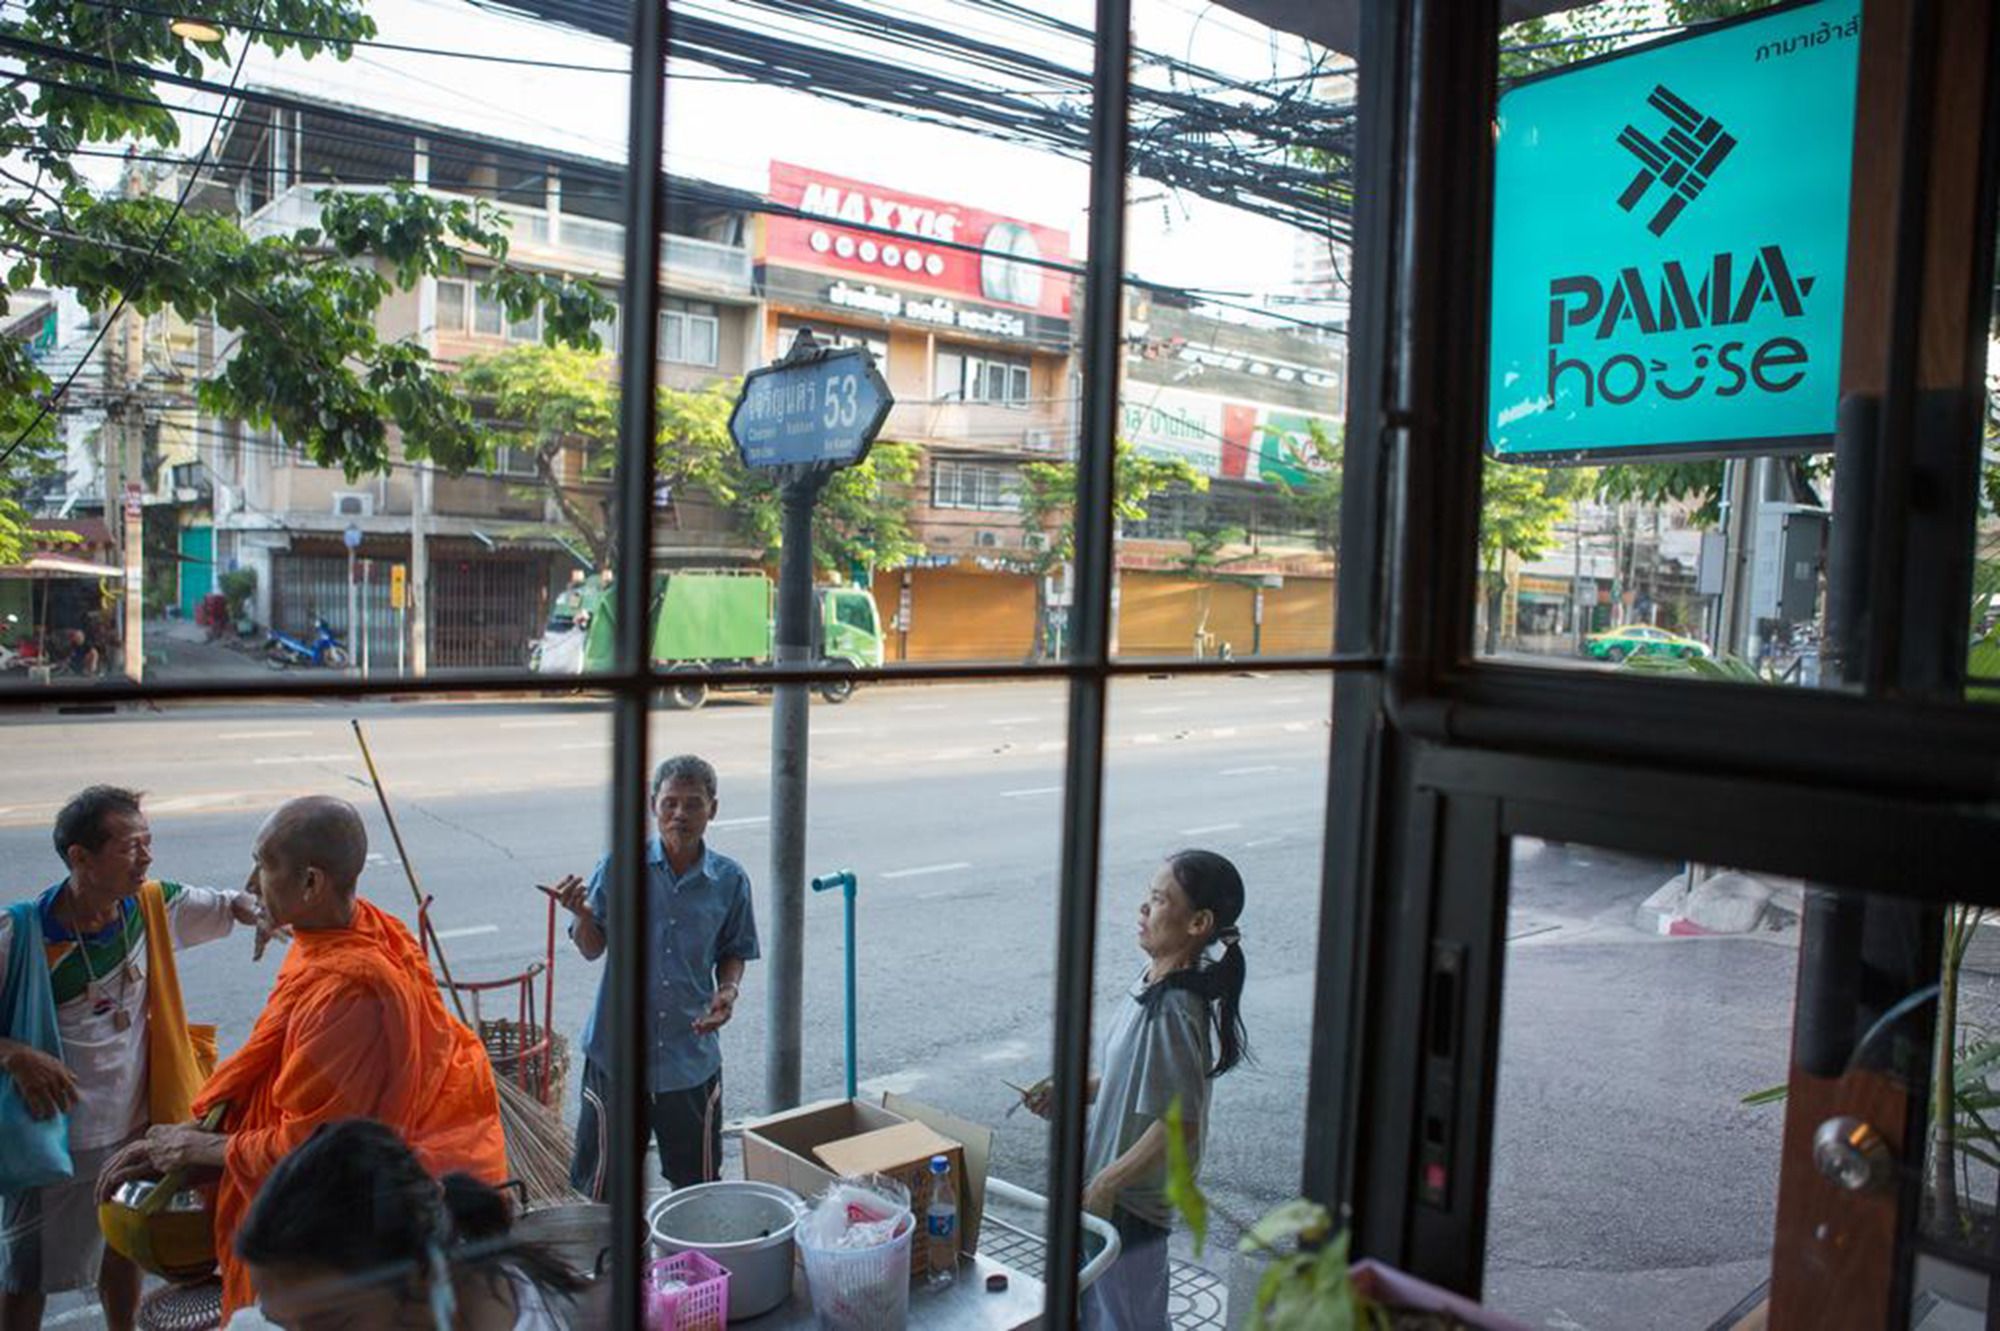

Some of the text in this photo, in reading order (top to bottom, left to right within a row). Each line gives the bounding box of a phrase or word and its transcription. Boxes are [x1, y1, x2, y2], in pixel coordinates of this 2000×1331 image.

[800, 183, 957, 243] MAXXIS
[1549, 245, 1816, 345] PAMA
[823, 374, 858, 429] 53
[1547, 336, 1809, 410] house
